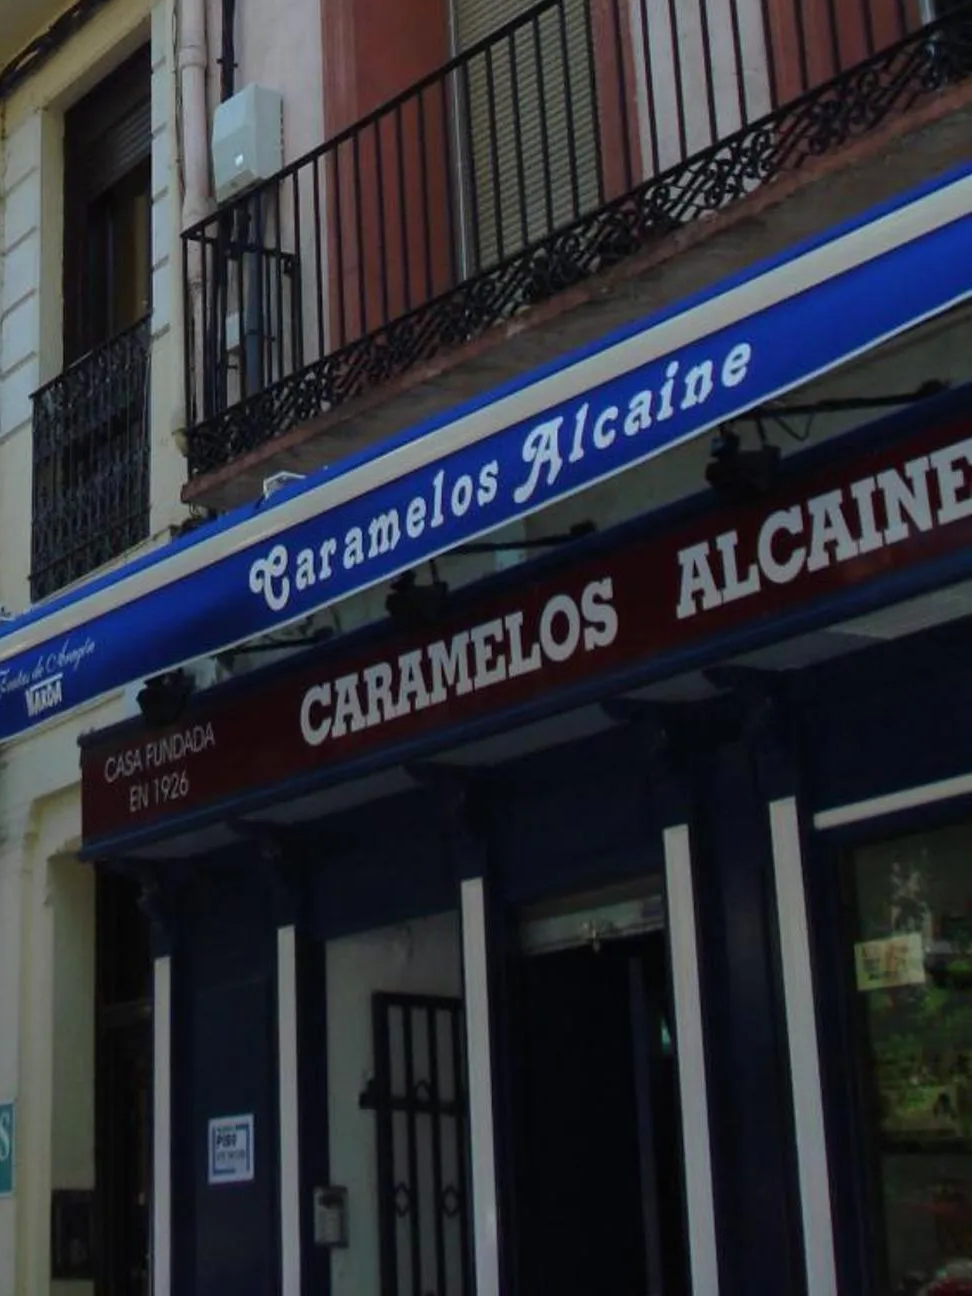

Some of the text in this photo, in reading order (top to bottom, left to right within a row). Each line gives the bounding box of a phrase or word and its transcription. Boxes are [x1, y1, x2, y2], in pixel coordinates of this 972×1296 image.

[248, 341, 754, 611] Caramelos Alcaine
[299, 437, 972, 748] CARAMELOS ALCAINE
[104, 721, 216, 783] CASA FUNDADA
[129, 769, 190, 813] EN 1926
